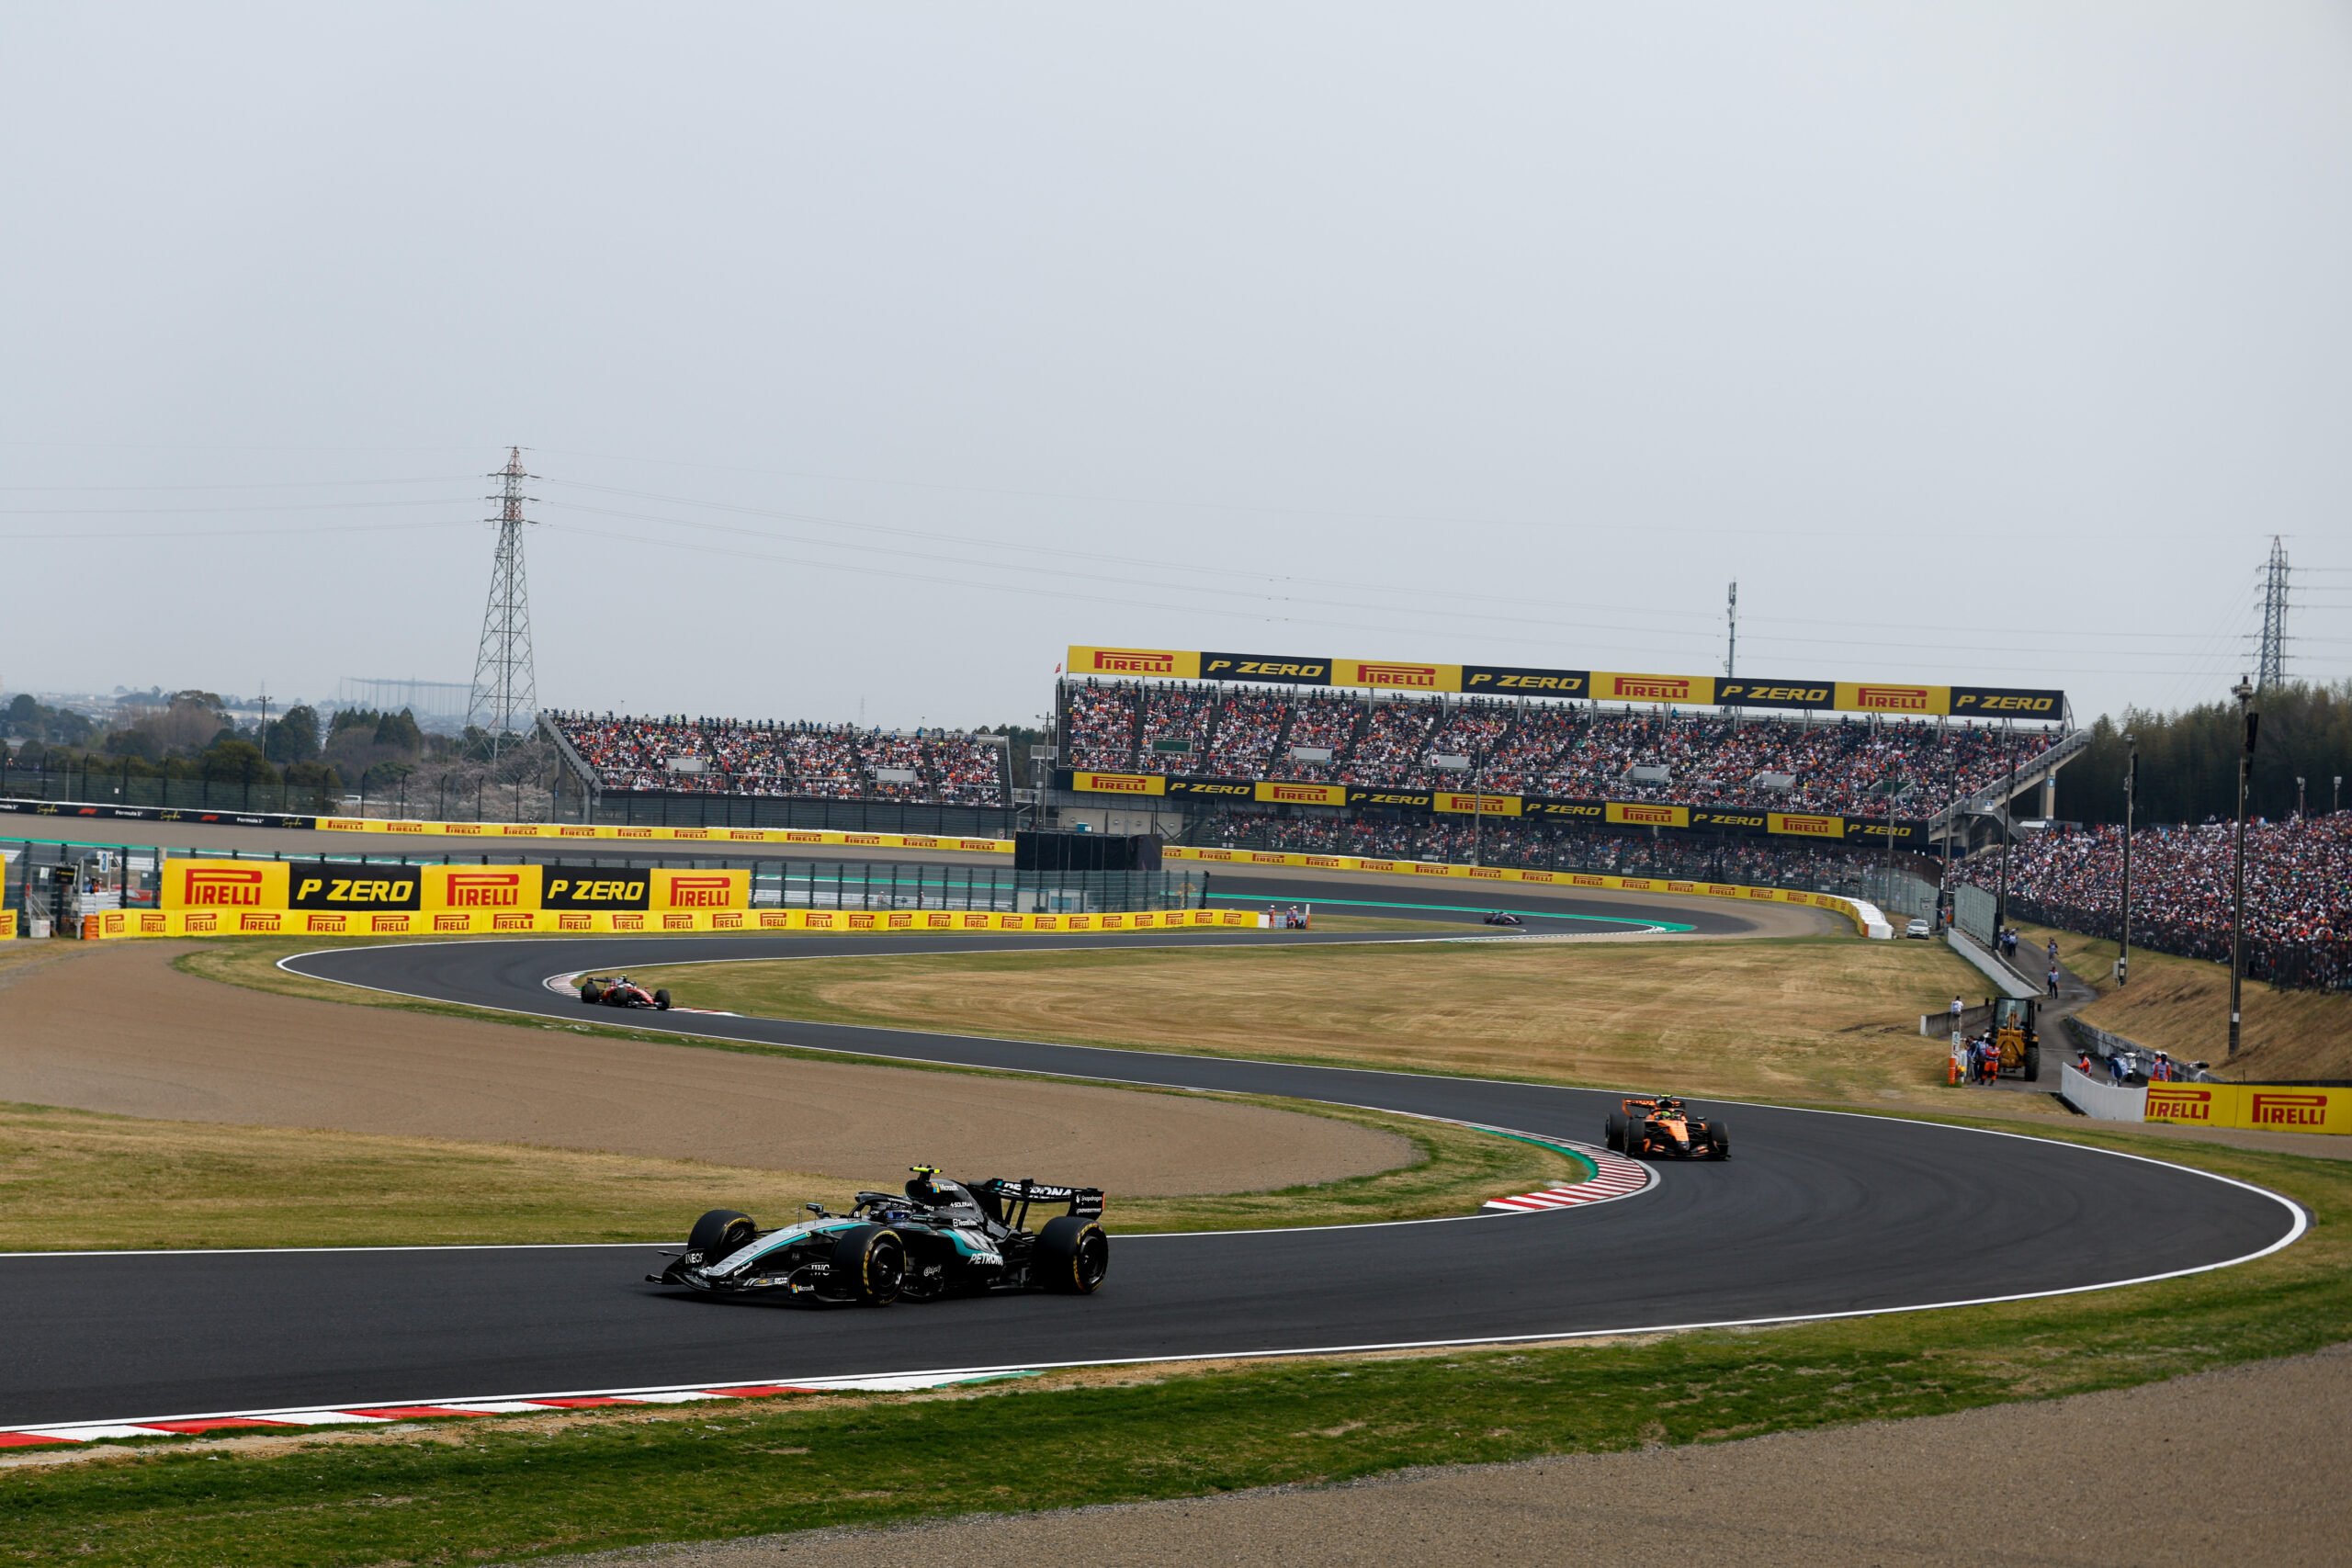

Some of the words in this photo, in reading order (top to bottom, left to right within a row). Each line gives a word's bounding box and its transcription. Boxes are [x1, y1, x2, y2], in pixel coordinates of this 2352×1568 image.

[1094, 651, 1174, 673] PIRELLI
[1208, 660, 1231, 671] P
[1237, 661, 1324, 677] ZERO
[1357, 665, 1436, 687] PIRELLI
[1470, 673, 1492, 685] P
[1497, 675, 1583, 690] ZERO
[1614, 677, 1690, 699] PIRELLI
[1722, 685, 1744, 697] P
[1748, 686, 1828, 701] ZERO
[1859, 687, 1928, 709] PIRELLI
[1958, 695, 1976, 707] P
[1981, 696, 2053, 711] ZERO
[1091, 776, 1147, 792] PIRELLI
[1170, 783, 1186, 791] P
[1190, 784, 1250, 795] ZERO
[1273, 786, 1328, 802] PIRELLI
[1351, 793, 1367, 801] P
[1370, 794, 1430, 806] ZERO
[1452, 796, 1504, 812] PIRELLI
[1526, 803, 1542, 812] P
[1544, 805, 1601, 816] ZERO
[1623, 807, 1672, 822] PIRELLI
[1693, 814, 1708, 822] P
[1711, 815, 1764, 826] ZERO
[1783, 818, 1828, 833] PIRELLI
[1848, 824, 1861, 832] P
[185, 868, 263, 906] PIRELLI
[297, 879, 322, 900] P
[326, 879, 413, 902] ZERO
[447, 874, 519, 907] PIRELLI
[548, 880, 569, 899] P
[571, 880, 645, 901] ZERO
[671, 876, 730, 907] PIRELLI
[106, 914, 124, 933] PIRELLI
[141, 914, 165, 932] PIRELLI
[186, 913, 217, 931] PIRELLI
[241, 913, 281, 931] PIRELLI
[307, 915, 346, 931] PIRELLI
[372, 916, 410, 931] PIRELLI
[435, 915, 469, 931] PIRELLI
[493, 913, 534, 929] PIRELLI
[559, 914, 591, 930] PIRELLI
[613, 915, 643, 930] PIRELLI
[663, 914, 693, 929] PIRELLI
[713, 913, 742, 928] PIRELLI
[760, 912, 786, 927] PIRELLI
[806, 913, 832, 928] PIRELLI
[848, 914, 875, 928] PIRELLI
[888, 914, 911, 928] PIRELLI
[928, 914, 951, 927] PIRELLI
[965, 915, 989, 928] PIRELLI
[1001, 916, 1023, 929] PIRELLI
[1035, 917, 1057, 929] PIRELLI
[1069, 917, 1090, 929] PIRELLI
[1102, 916, 1122, 929] PIRELLI
[1135, 915, 1153, 927] PIRELLI
[1166, 913, 1184, 925] PIRELLI
[1195, 912, 1213, 924] PIRELLI
[1224, 913, 1242, 925] PIRELLI
[2144, 1089, 2211, 1120] PIRELLI
[2252, 1094, 2328, 1125] PIRELLI
[685, 1252, 704, 1265] INEOS
